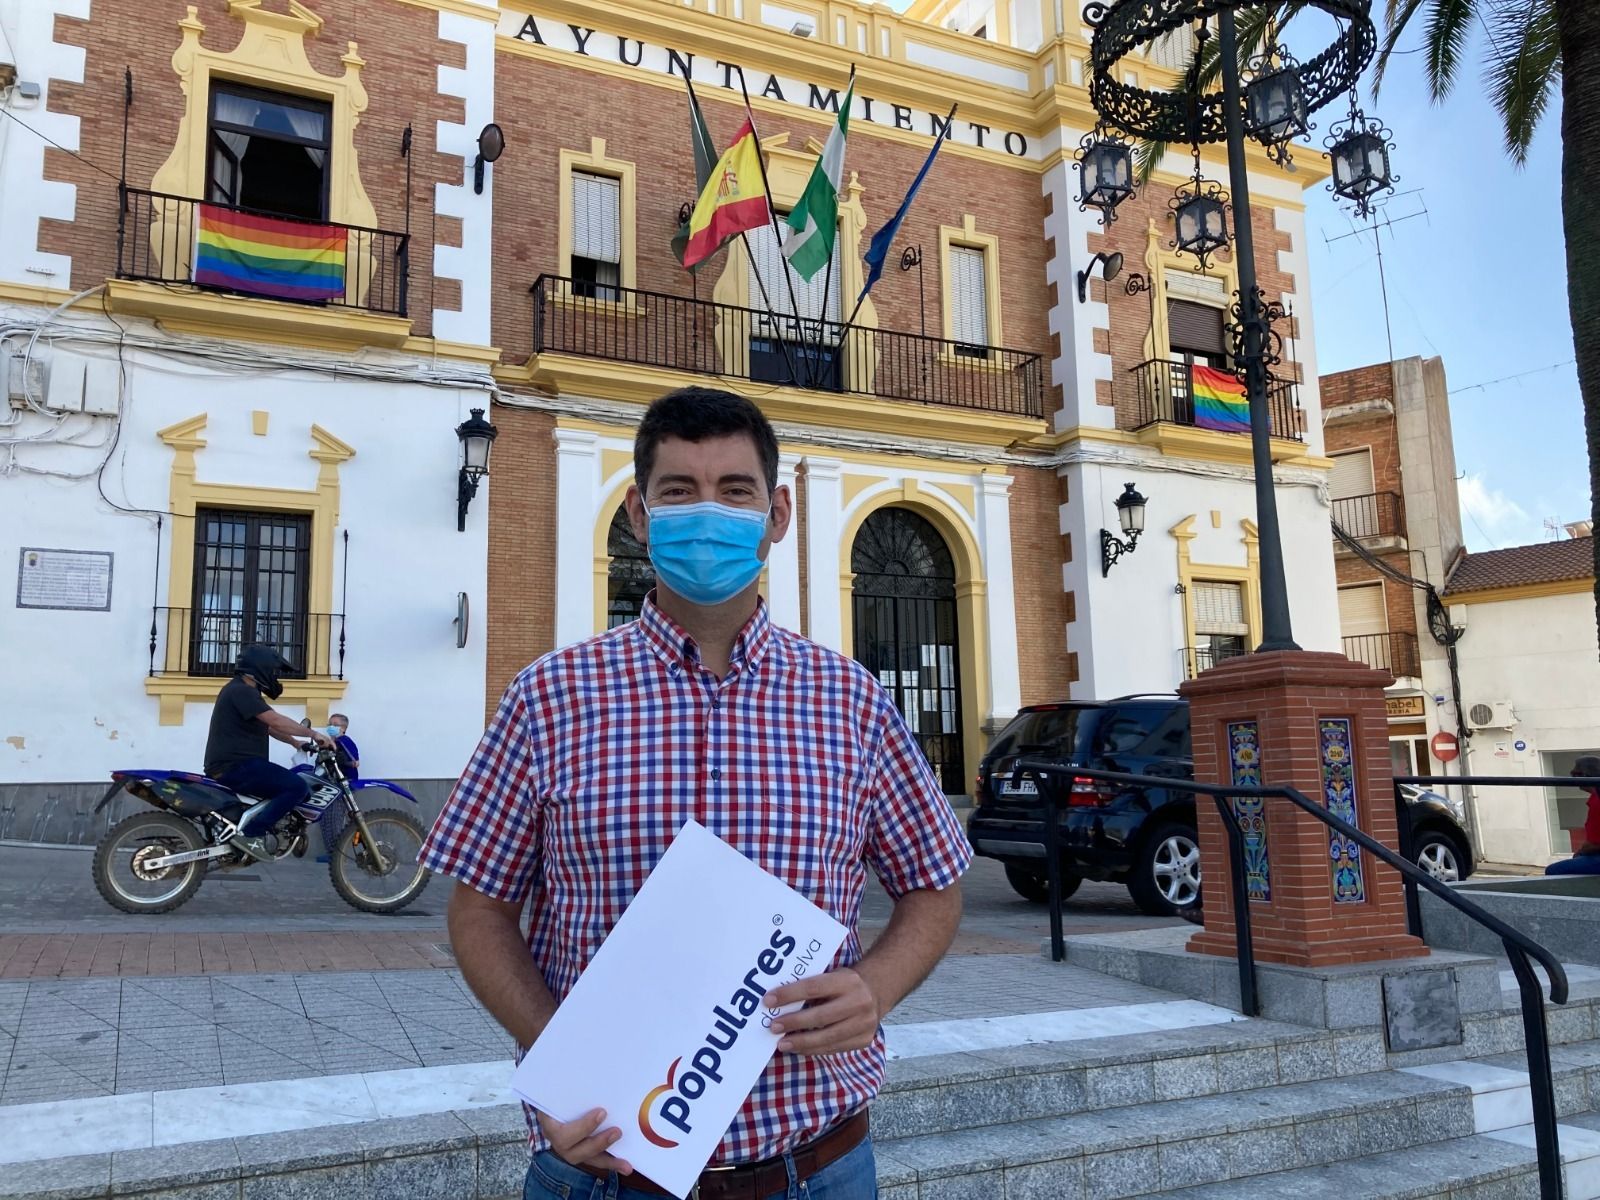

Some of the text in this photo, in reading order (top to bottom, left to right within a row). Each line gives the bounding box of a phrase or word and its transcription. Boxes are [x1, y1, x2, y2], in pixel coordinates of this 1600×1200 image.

[514, 14, 1028, 157] AYUNTAMIENTO
[660, 928, 796, 1134] populares
[761, 938, 822, 1028] de uelva
